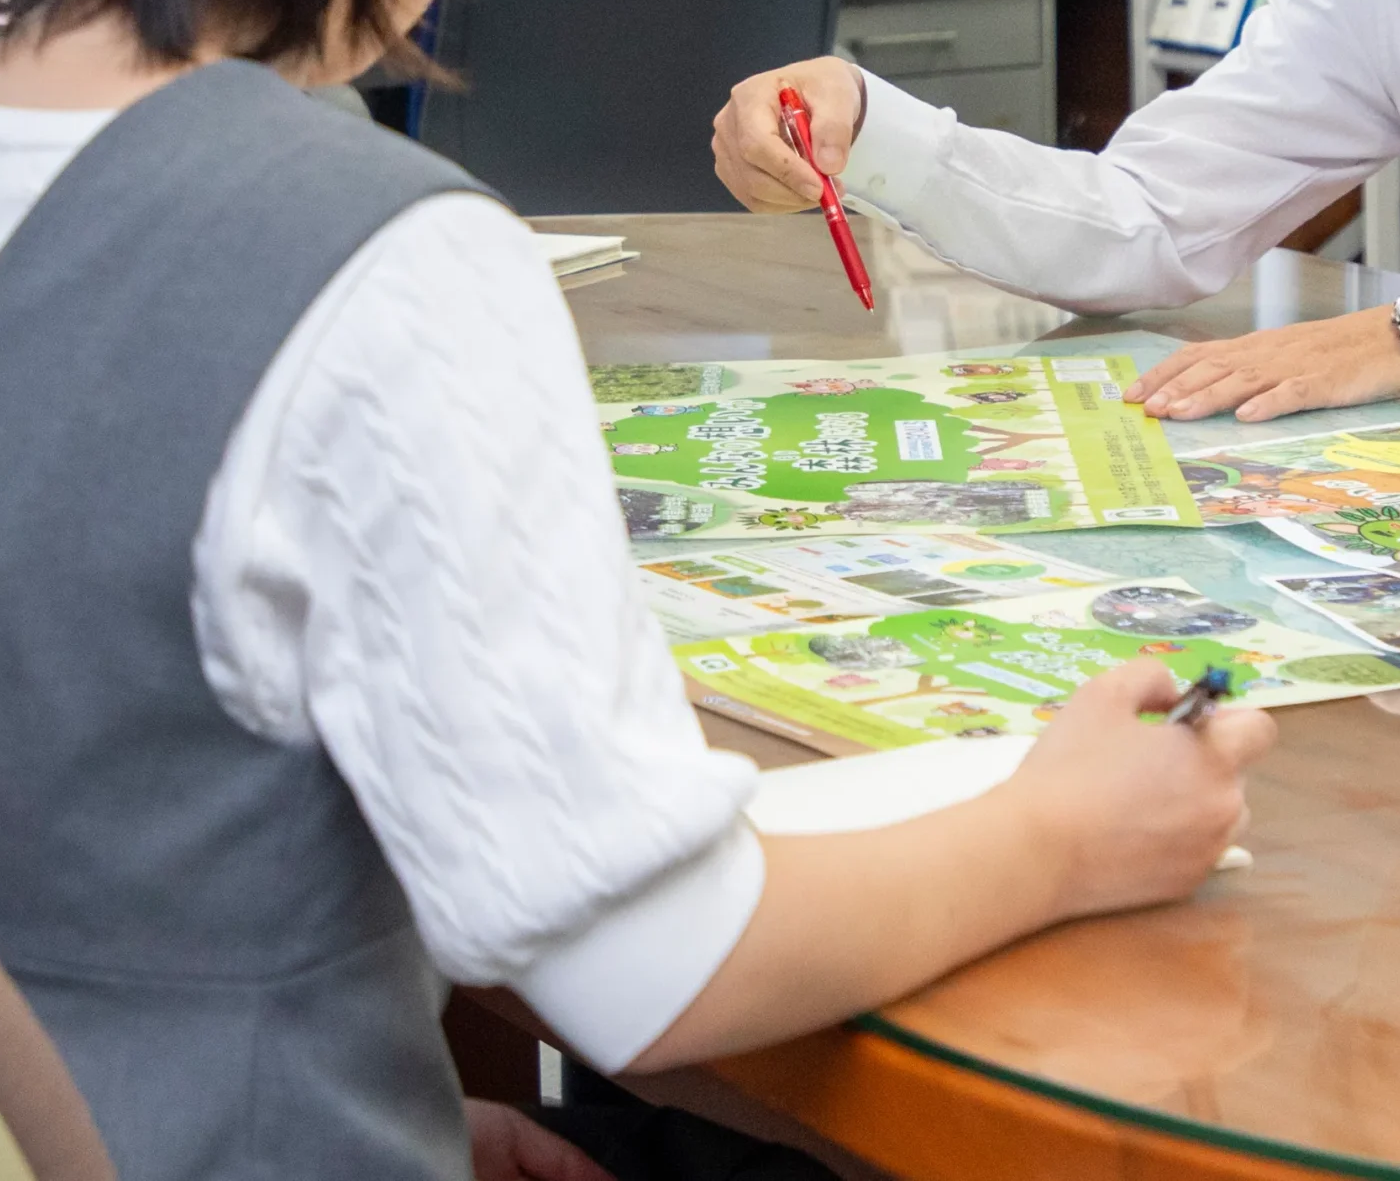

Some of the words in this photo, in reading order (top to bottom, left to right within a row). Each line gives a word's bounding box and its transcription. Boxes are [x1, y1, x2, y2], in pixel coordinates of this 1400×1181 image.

[687, 399, 771, 490] みんなの想いが
